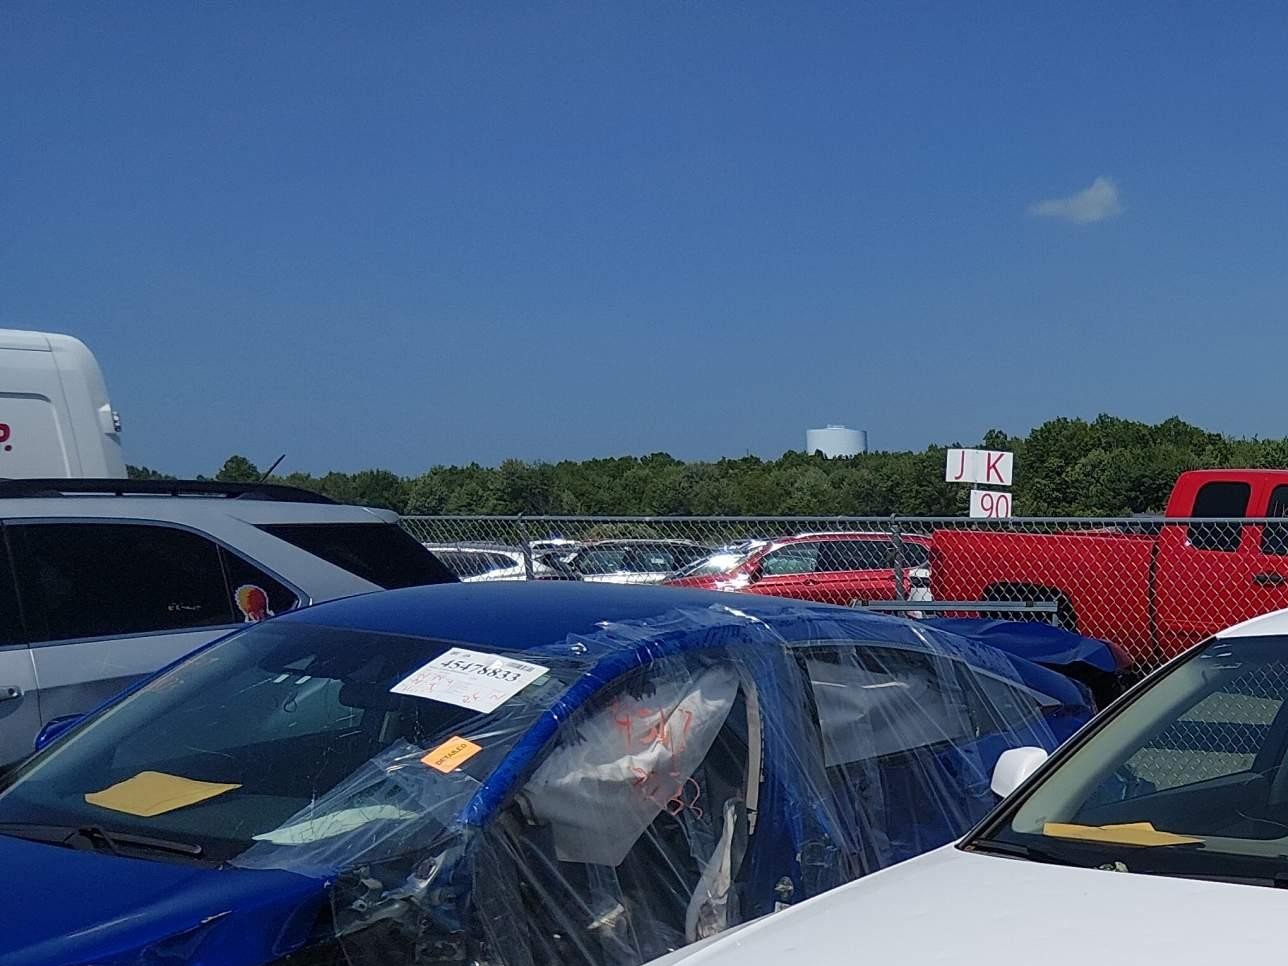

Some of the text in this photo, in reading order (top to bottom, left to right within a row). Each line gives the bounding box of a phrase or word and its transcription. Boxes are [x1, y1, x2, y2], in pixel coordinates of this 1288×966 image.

[955, 450, 1005, 484] J K
[980, 493, 1009, 518] 90
[440, 658, 521, 682] 45478833
